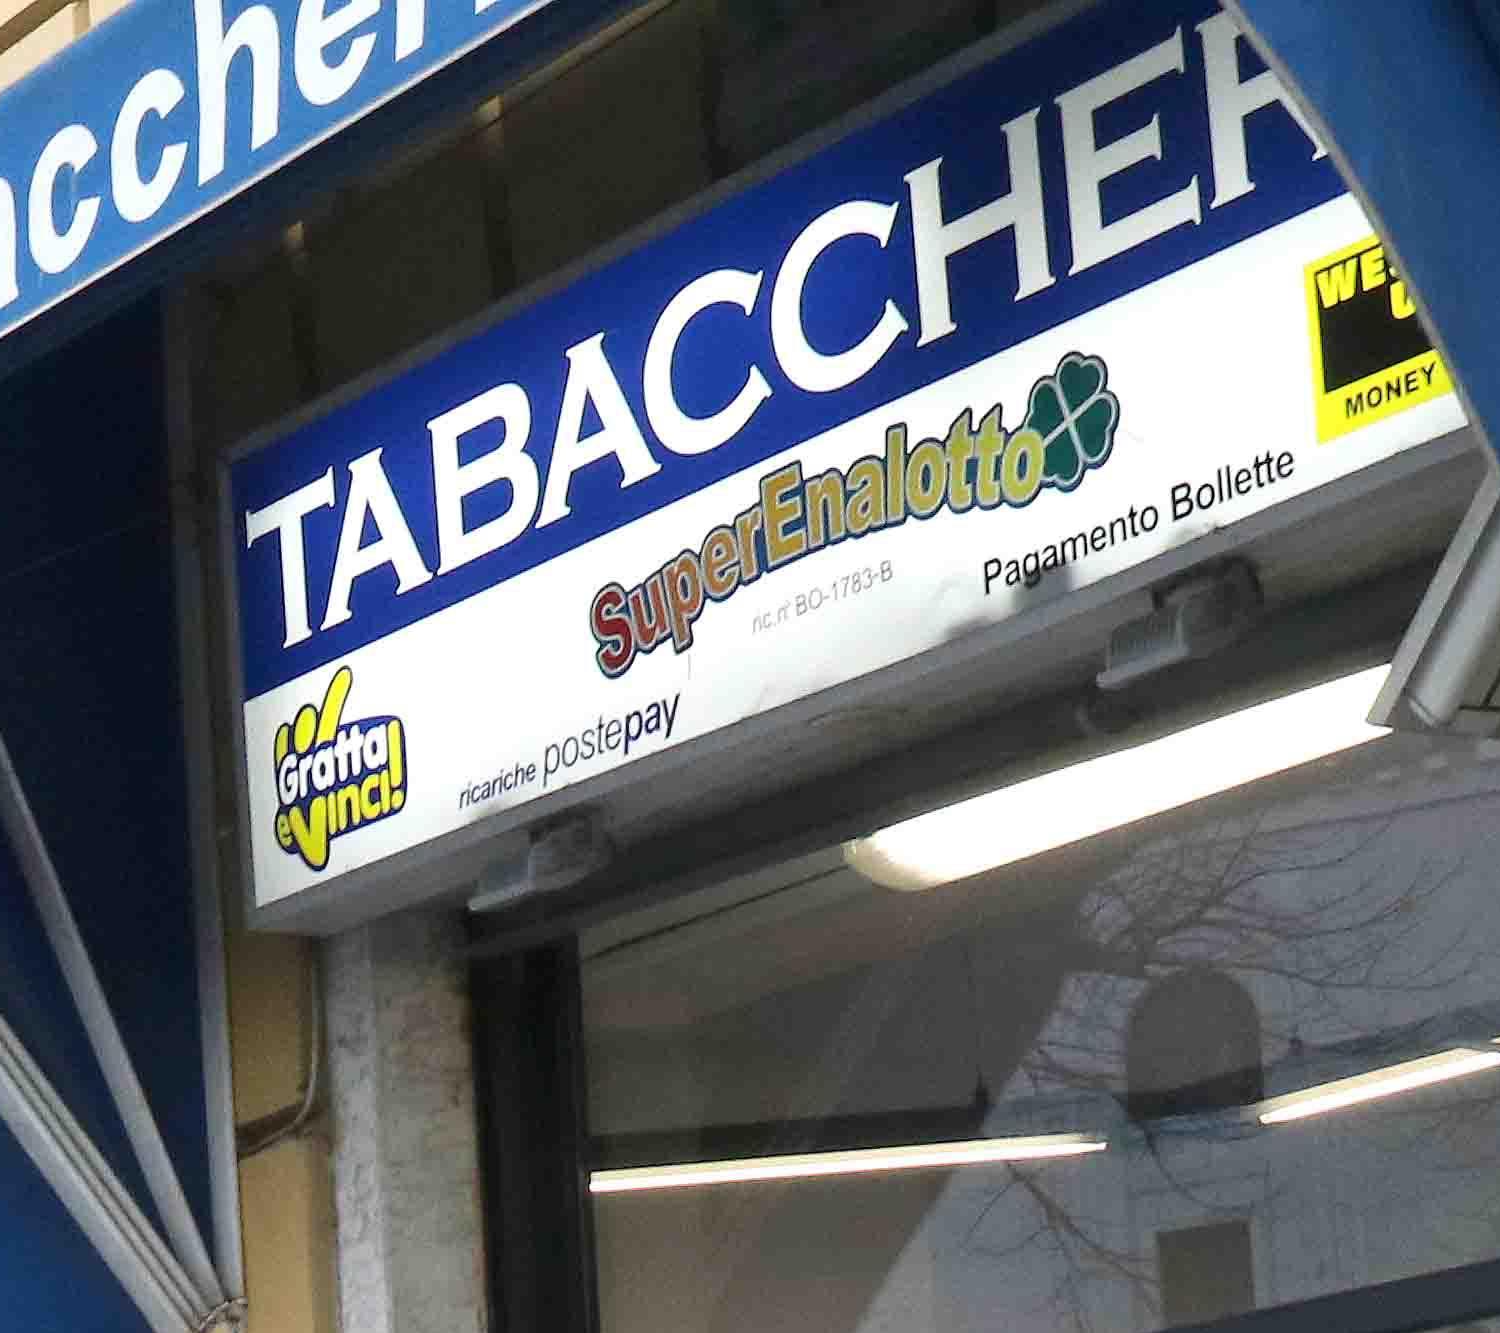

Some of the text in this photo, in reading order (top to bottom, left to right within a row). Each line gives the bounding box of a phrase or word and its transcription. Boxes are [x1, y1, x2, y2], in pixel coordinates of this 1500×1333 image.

[1345, 360, 1436, 418] MONEY
[589, 403, 1045, 678] SuperEnalotto
[982, 447, 1296, 597] Pagamento Bollette
[795, 557, 894, 616] BO-1783-B
[276, 722, 388, 805] Gratta
[458, 692, 681, 810] ricariche postepay
